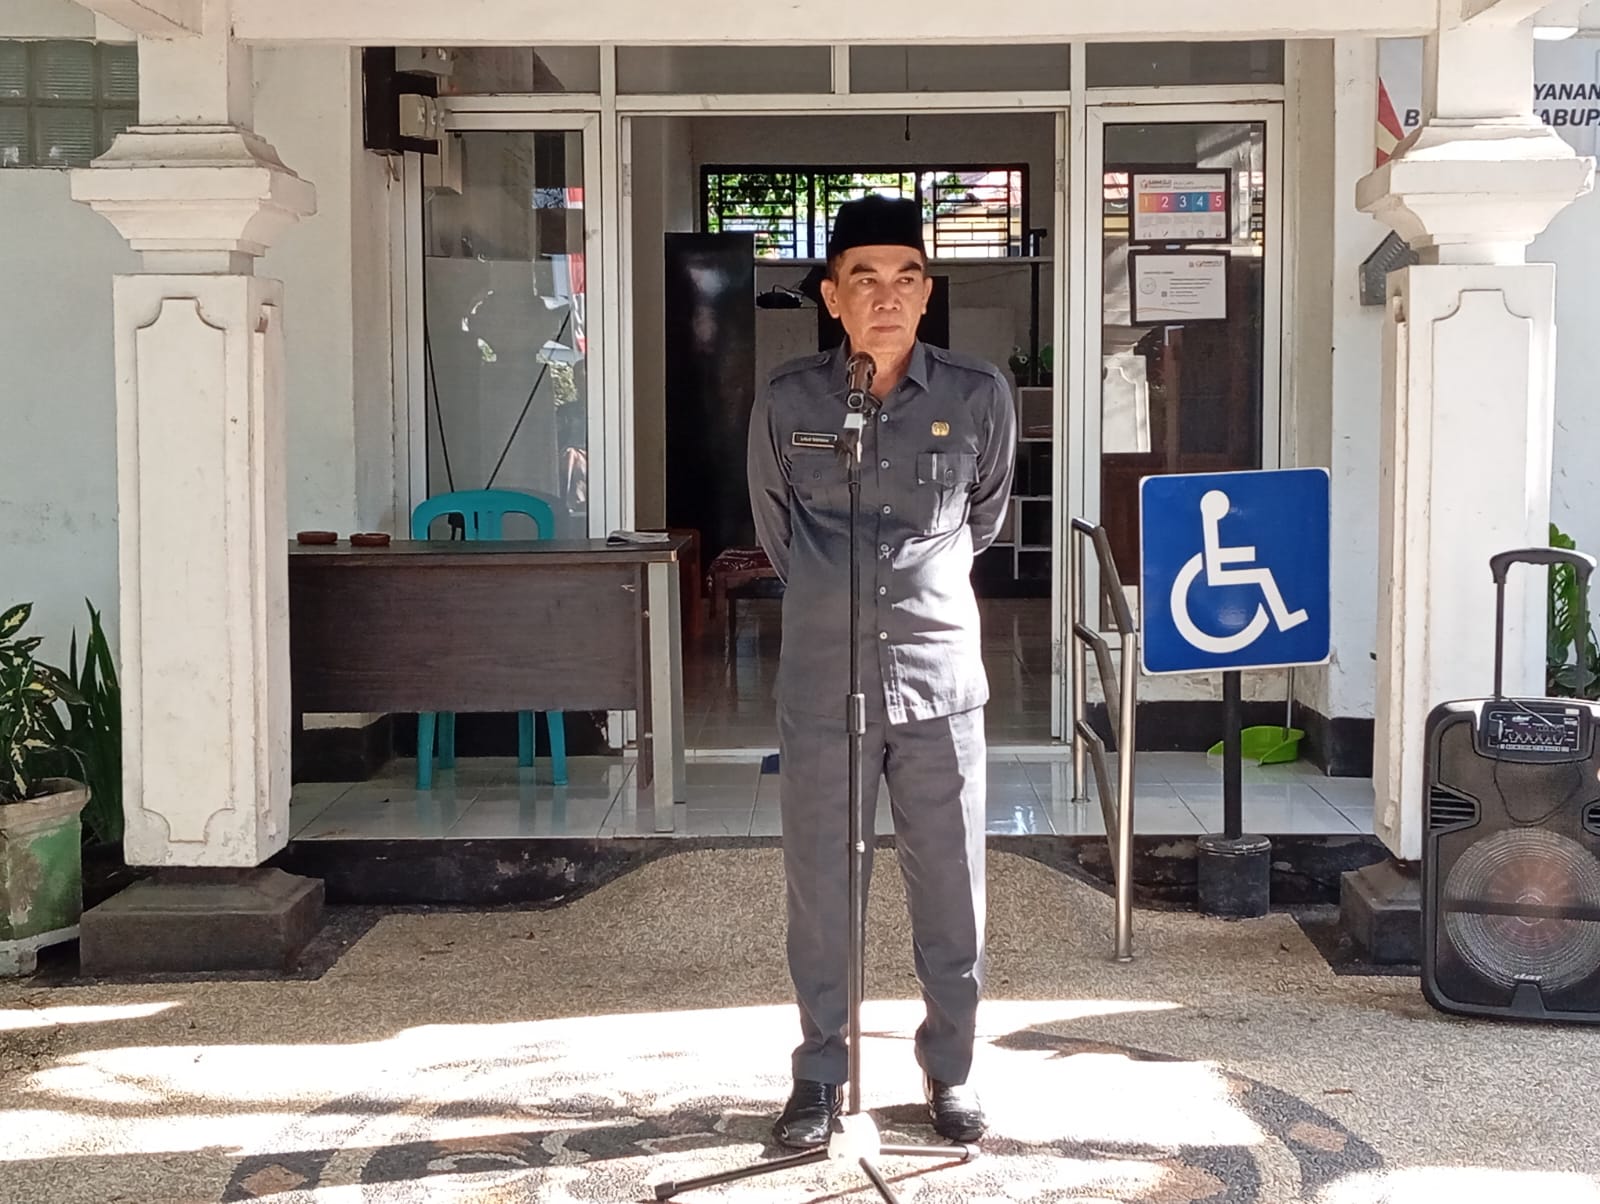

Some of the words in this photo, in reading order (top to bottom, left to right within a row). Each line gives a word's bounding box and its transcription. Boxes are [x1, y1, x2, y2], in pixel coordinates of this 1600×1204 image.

[1534, 109, 1600, 126] ABUP
[1161, 196, 1169, 208] 2
[1179, 195, 1187, 208] 3
[1196, 195, 1204, 207] 4
[1215, 195, 1222, 207] 5
